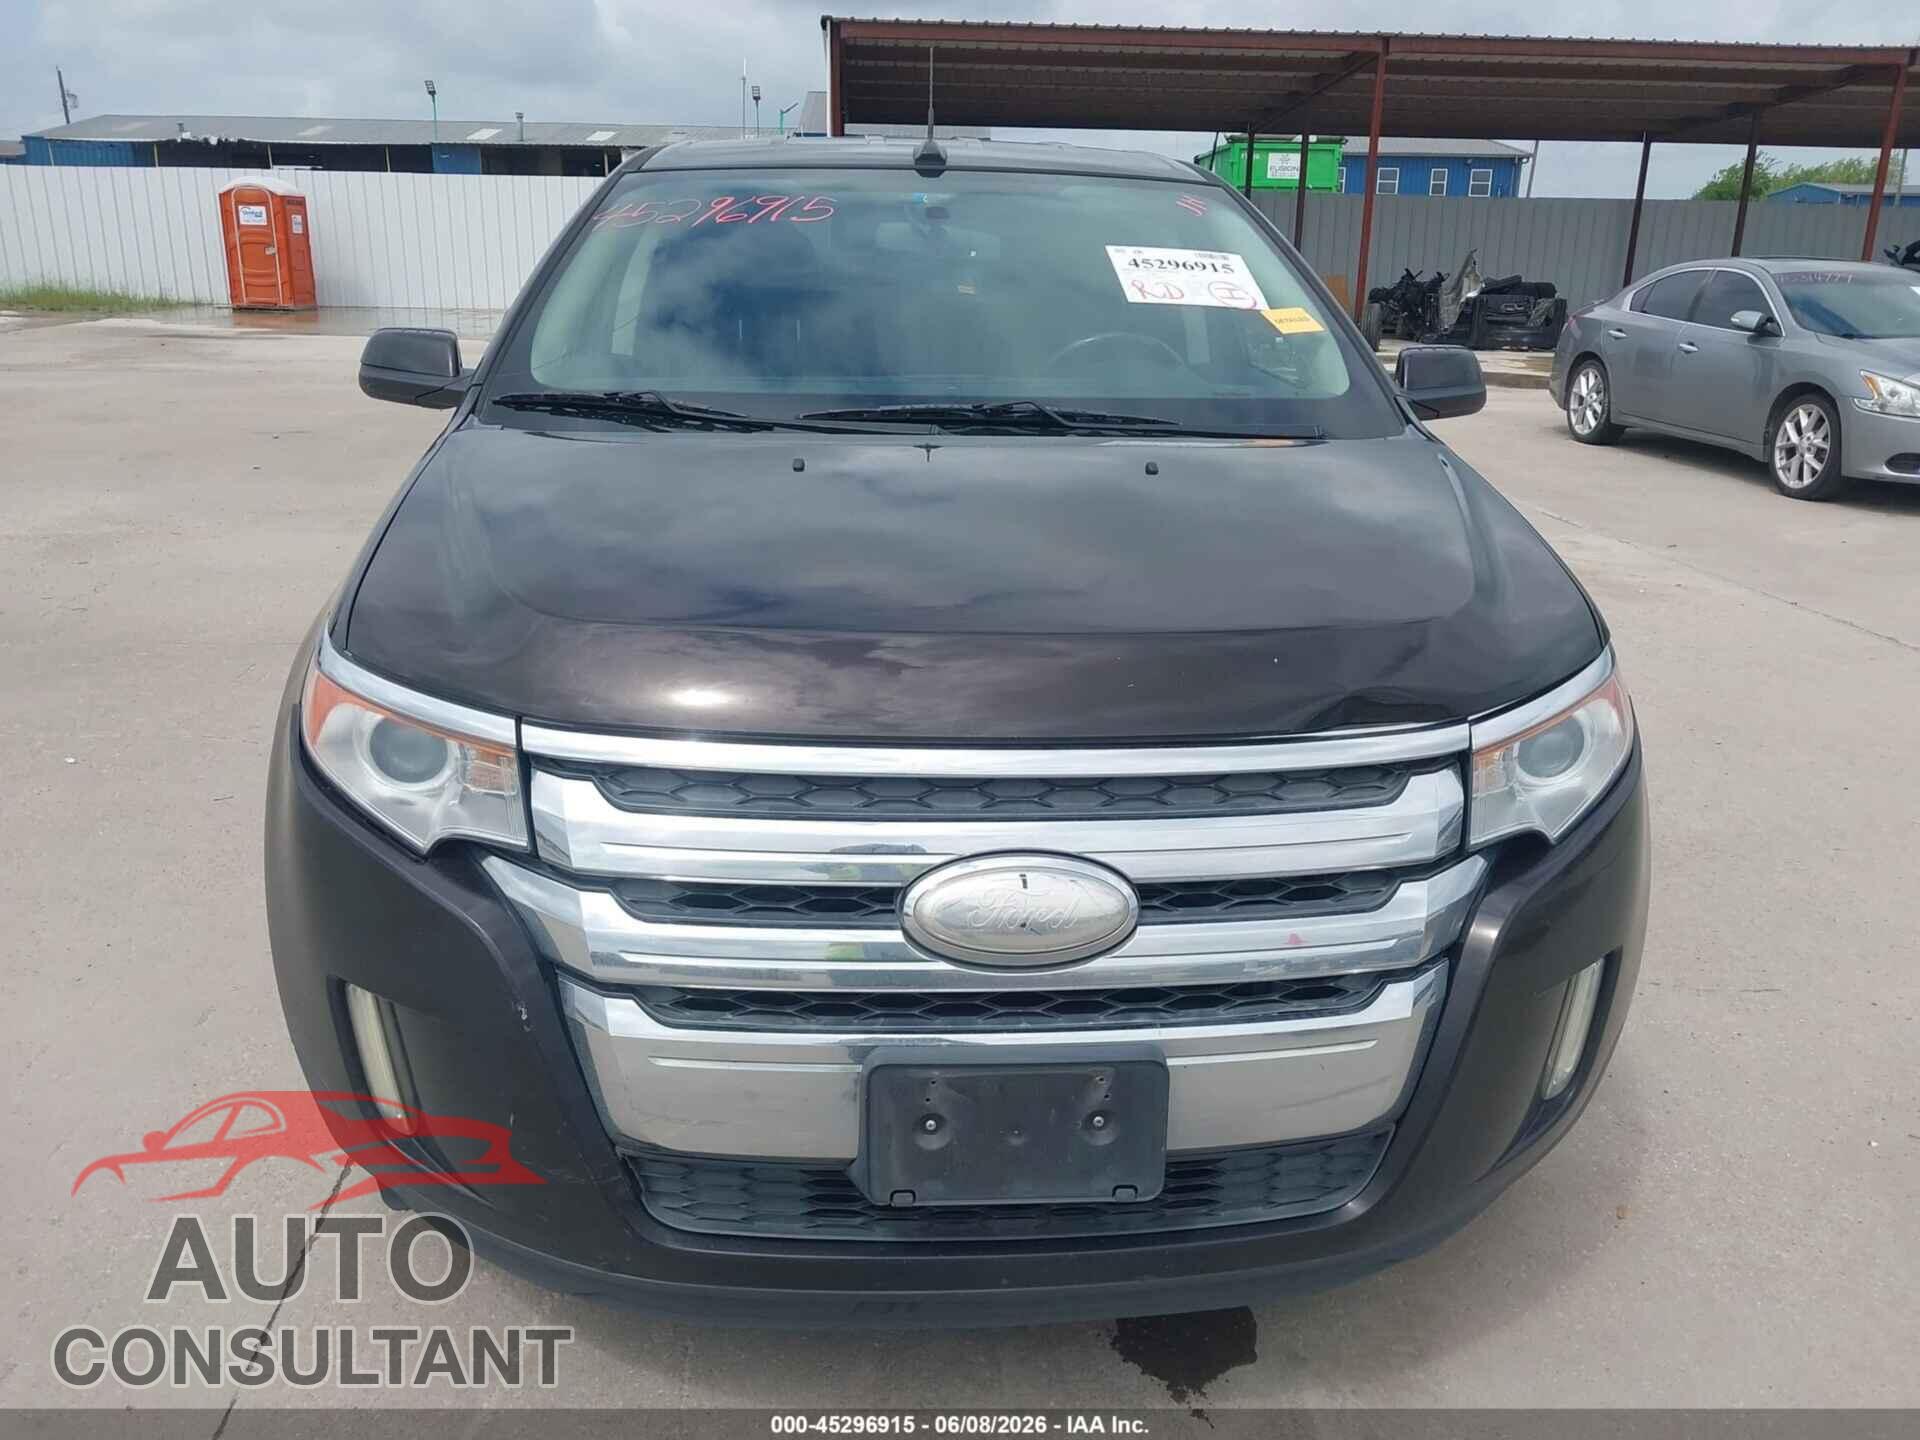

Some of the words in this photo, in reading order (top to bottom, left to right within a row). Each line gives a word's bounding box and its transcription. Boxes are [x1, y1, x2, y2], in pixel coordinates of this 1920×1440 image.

[593, 196, 837, 229] 45296915
[1128, 257, 1235, 274] 45296915
[968, 888, 1079, 929] Ford
